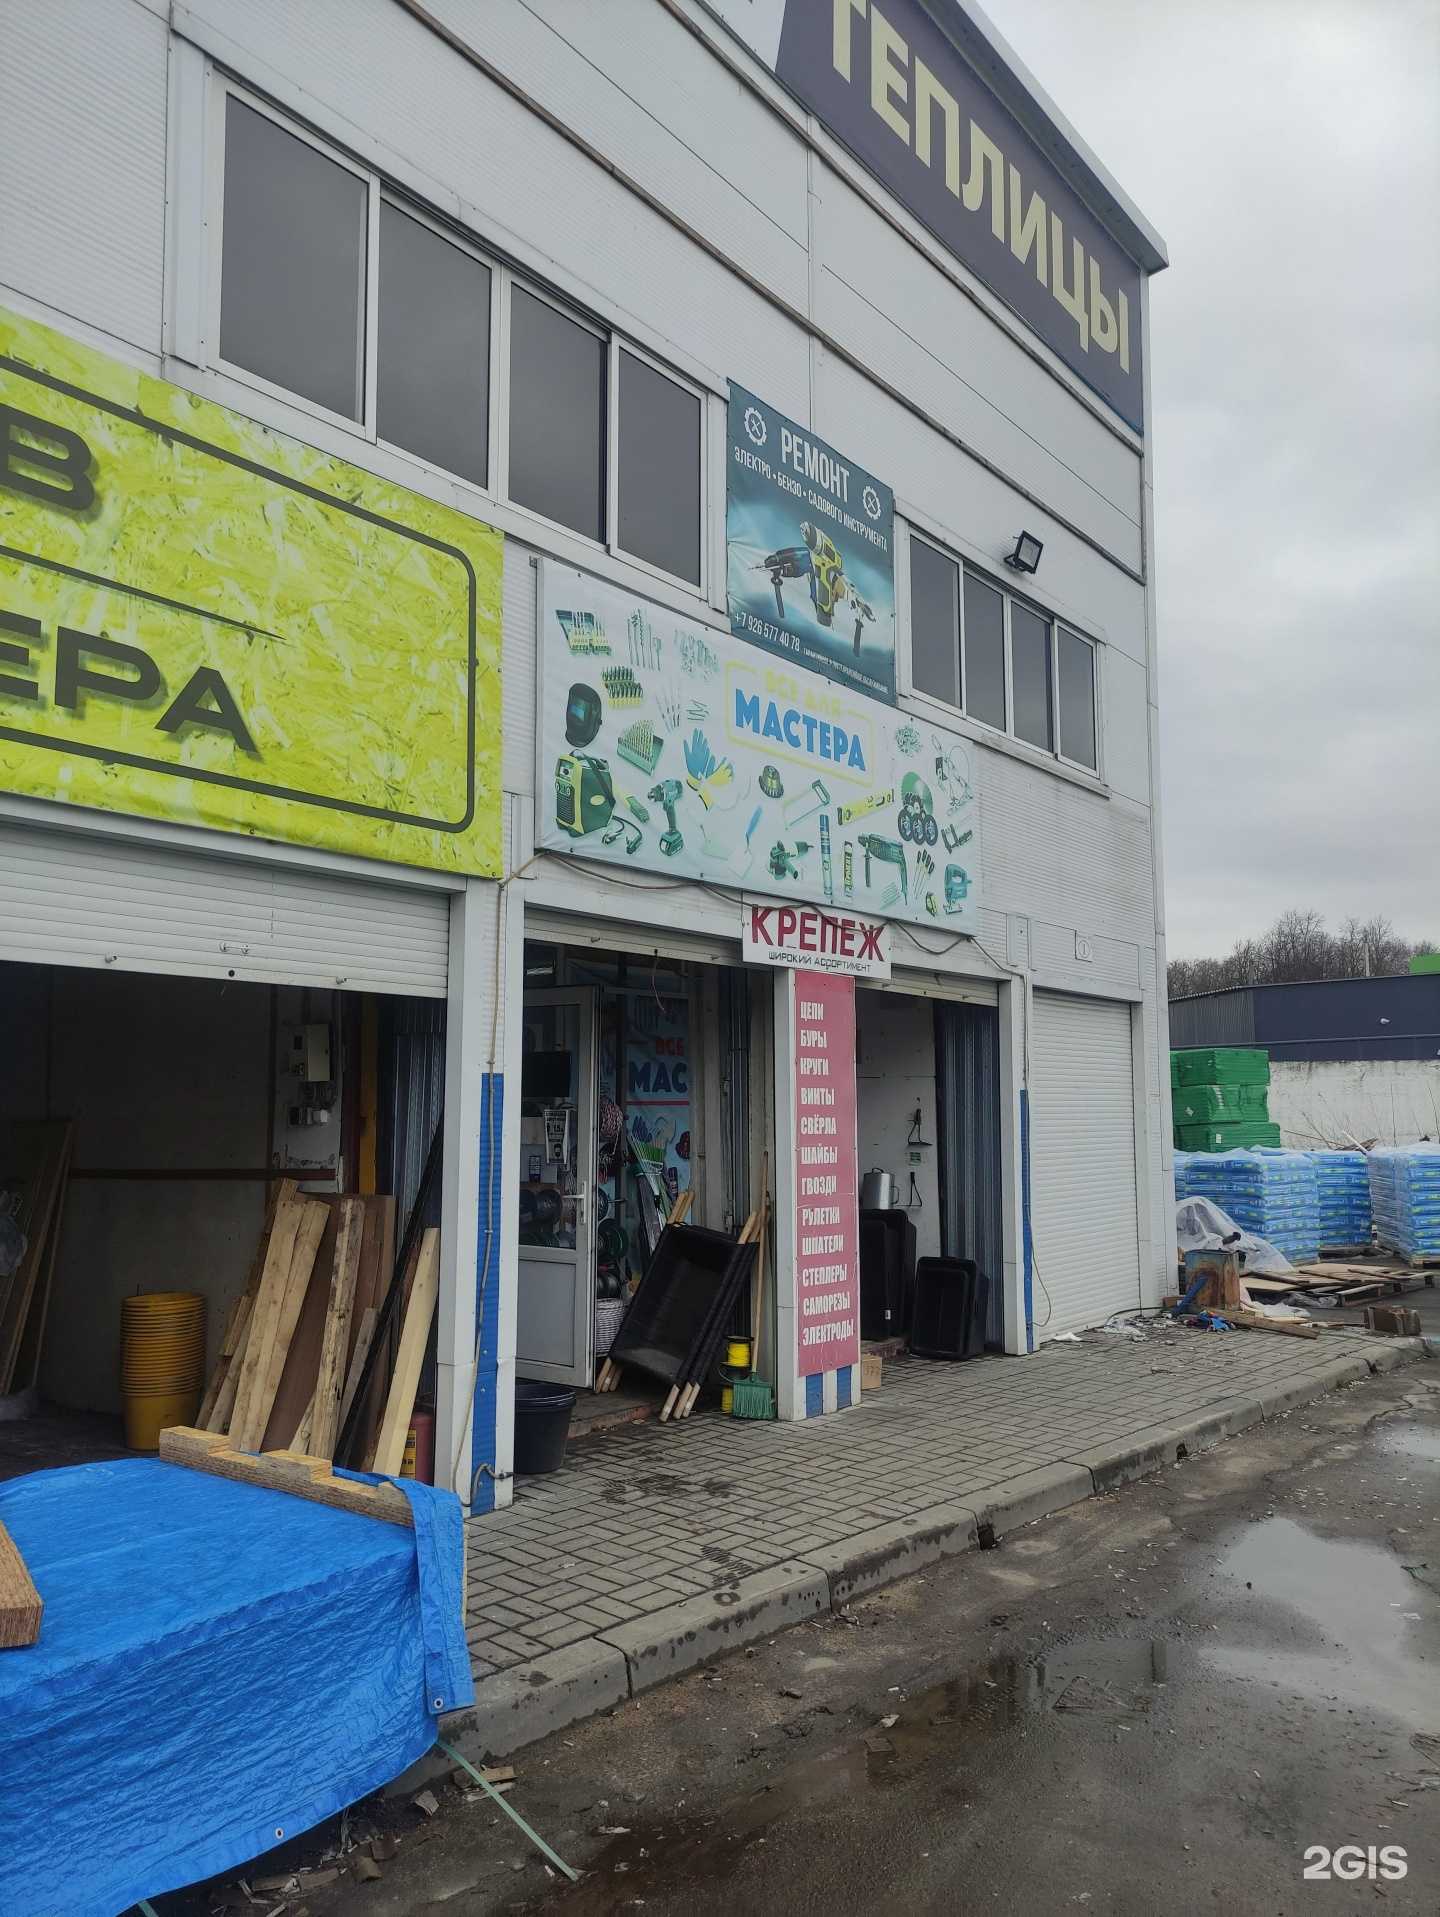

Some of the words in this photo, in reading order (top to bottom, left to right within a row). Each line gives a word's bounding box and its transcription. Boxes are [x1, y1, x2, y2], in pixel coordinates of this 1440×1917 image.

[780, 426, 850, 504] РЕМОНТ
[734, 446, 771, 480] ЭЛЕКТРО
[777, 472, 802, 498] БЕНЗО
[808, 489, 843, 524] САДОВОГО
[843, 514, 888, 553] ИНСТРУМЕНТА
[735, 611, 747, 628] +7
[748, 615, 763, 635] 926
[763, 623, 778, 642] 577
[780, 631, 789, 648] 40
[791, 635, 800, 652] 78
[735, 688, 867, 772] МАСТЕРА
[751, 904, 885, 962] КРЕПЕЖ
[768, 950, 811, 964] ШИРОКИЙ
[814, 957, 871, 973] АССОРТИМЕНТ
[800, 1001, 824, 1021] ЦЕПИ
[800, 1029, 827, 1049] БУРЫ
[800, 1058, 829, 1076] КРУГИ
[800, 1087, 835, 1106] ВИНТЫ
[800, 1114, 837, 1135] СВЁРЛА
[801, 1143, 838, 1165] ШАЙБЫ
[801, 1175, 837, 1197] ГВОЗДИ
[802, 1206, 840, 1226] РУЛЕТКИ
[802, 1233, 844, 1256] ШПАТЕЛИ
[802, 1262, 847, 1287] СТЕПЛЕРЫ
[803, 1291, 850, 1317] САМОРЕЗЫ
[802, 1319, 854, 1346] ЭЛЕКТРОДЫ
